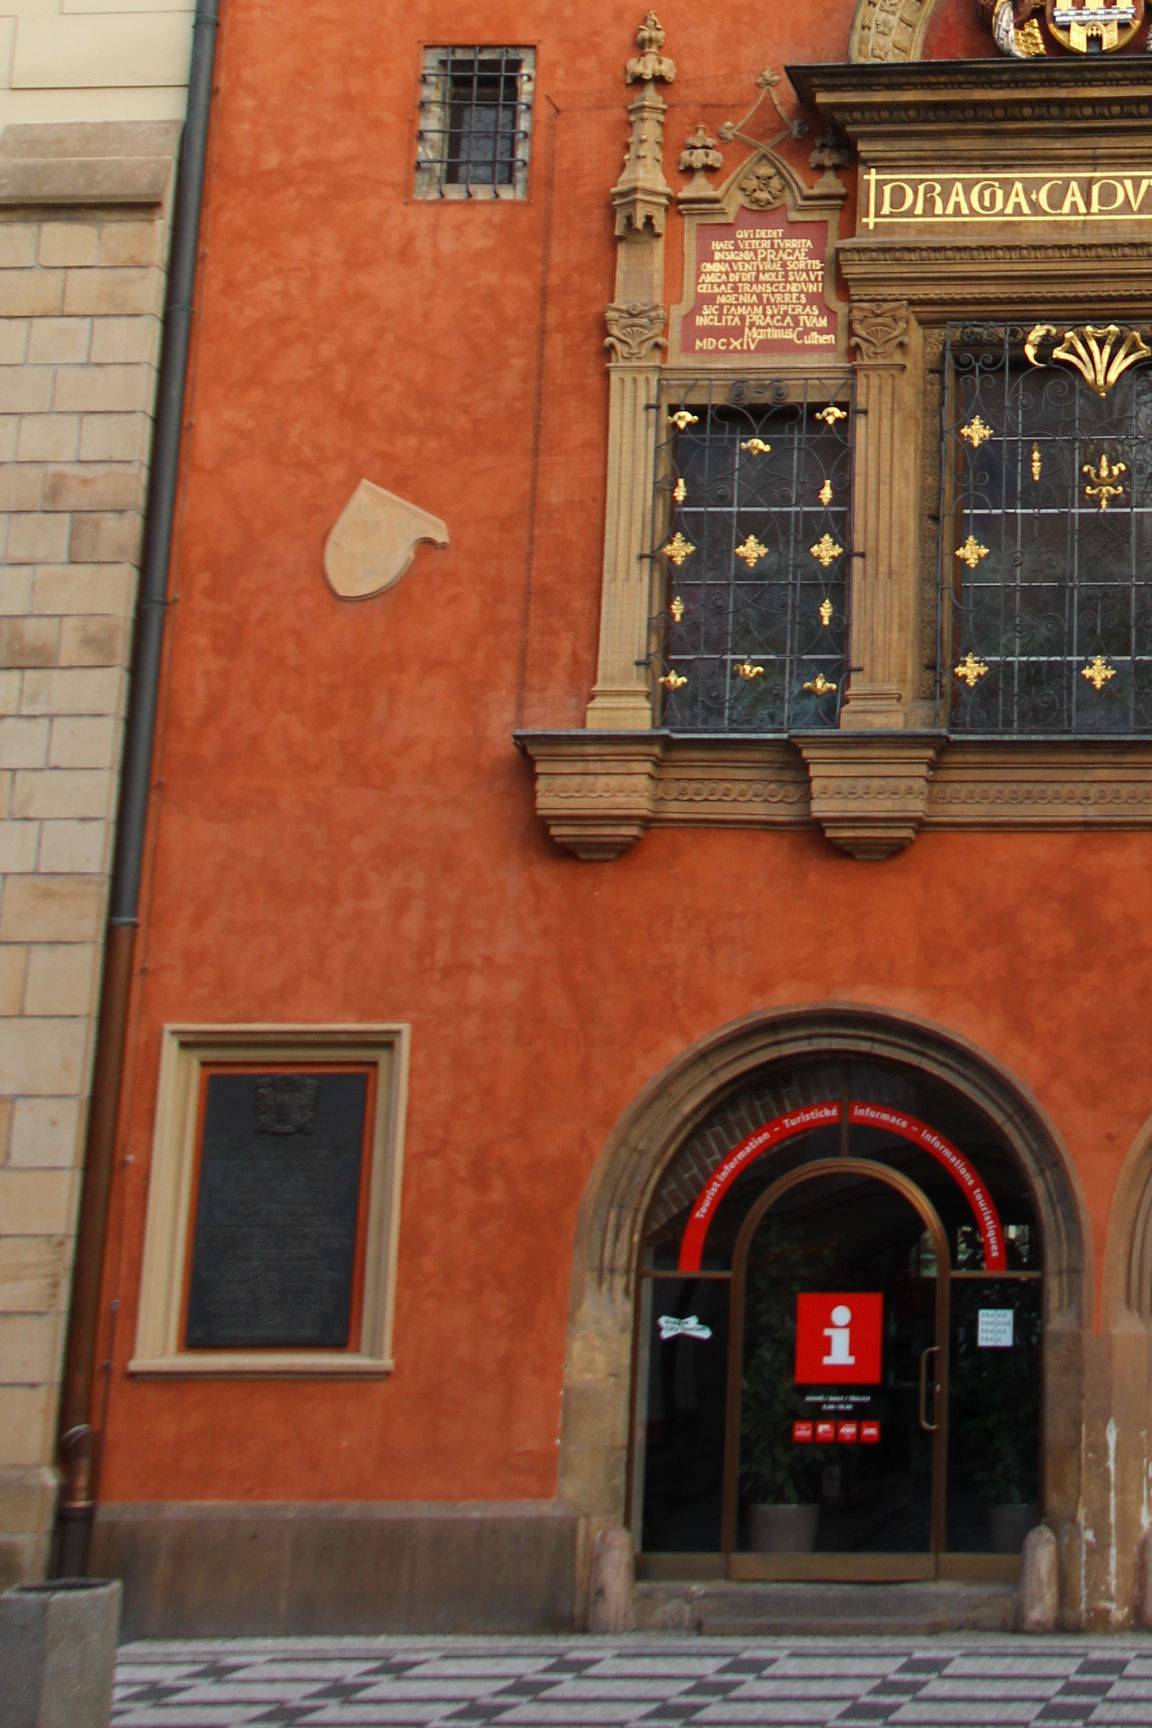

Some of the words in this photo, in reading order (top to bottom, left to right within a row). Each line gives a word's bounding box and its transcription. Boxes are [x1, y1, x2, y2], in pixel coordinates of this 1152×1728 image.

[880, 180, 1031, 215] PRAGA
[756, 229, 784, 238] DEDIT
[738, 239, 771, 249] VETERI
[773, 239, 813, 248] TVRRITA
[732, 261, 784, 271] VENTVRAE
[737, 282, 823, 292] TRANSCENDVNT
[716, 294, 758, 304] MOENIA
[762, 293, 807, 303] TVRRES
[702, 305, 719, 315] SIC
[766, 305, 819, 315] SVPERAS
[695, 315, 741, 326] INCLITA
[798, 315, 828, 327] TVAM
[745, 327, 794, 339] Martinus
[694, 1182, 721, 1219] Tourist
[716, 1132, 771, 1182] information
[783, 1106, 838, 1128] Turistické
[973, 1188, 999, 1257] touristiques
